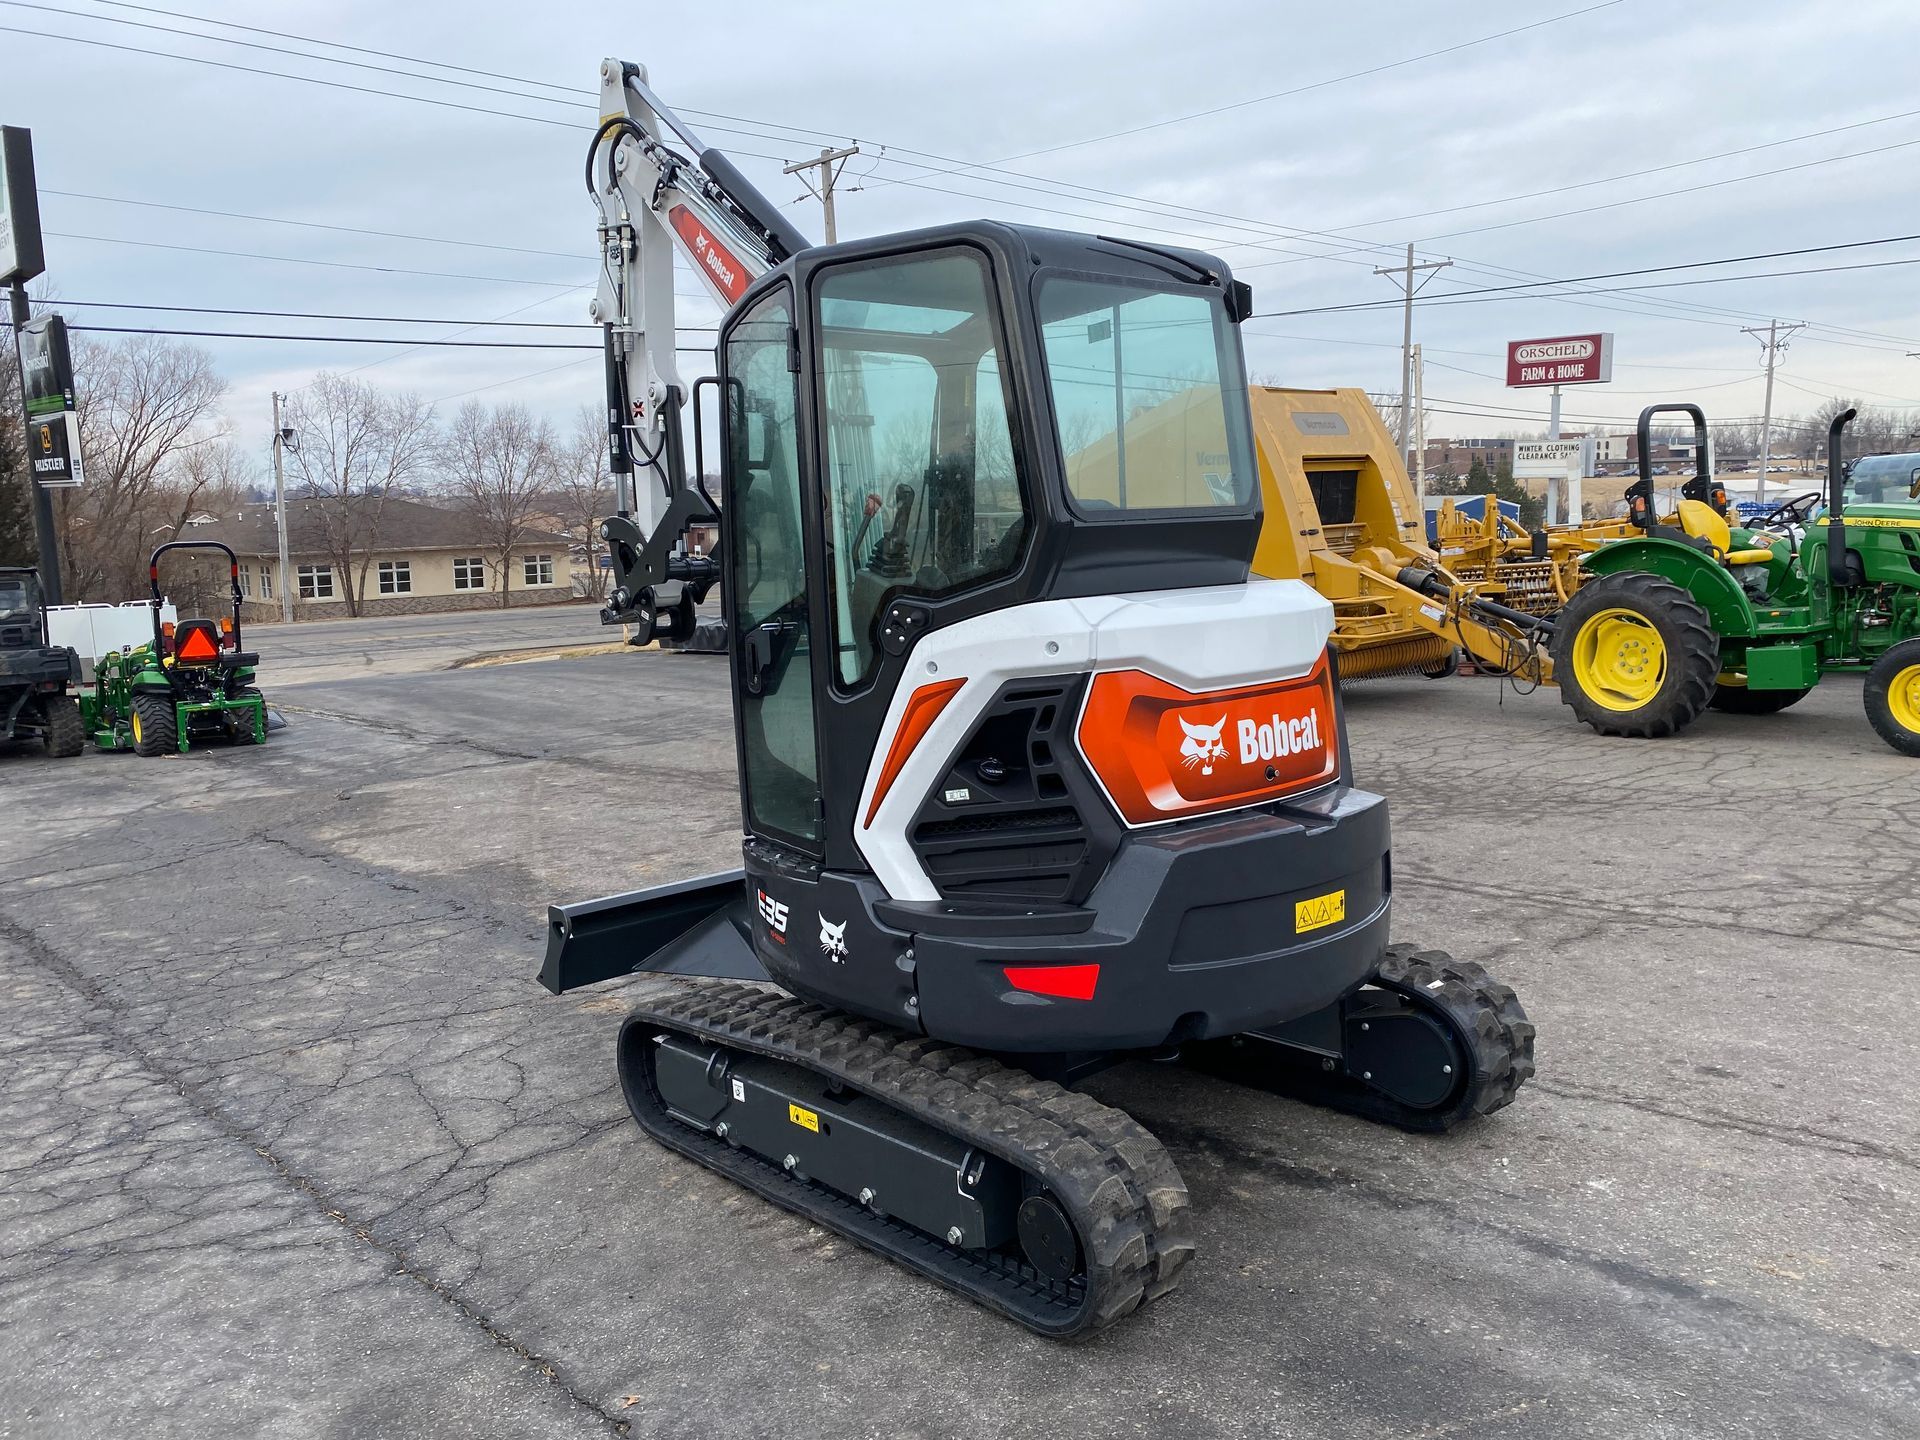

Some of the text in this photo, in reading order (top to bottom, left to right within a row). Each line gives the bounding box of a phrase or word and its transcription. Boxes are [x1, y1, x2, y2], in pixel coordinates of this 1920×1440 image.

[705, 247, 735, 288] Bobcat
[1520, 344, 1588, 359] ORSCHELN
[1521, 364, 1585, 381] FARM & HOME
[1518, 452, 1557, 460] CLEARANCE
[34, 457, 65, 472] HUSTLER
[1237, 707, 1320, 765] Bobcat
